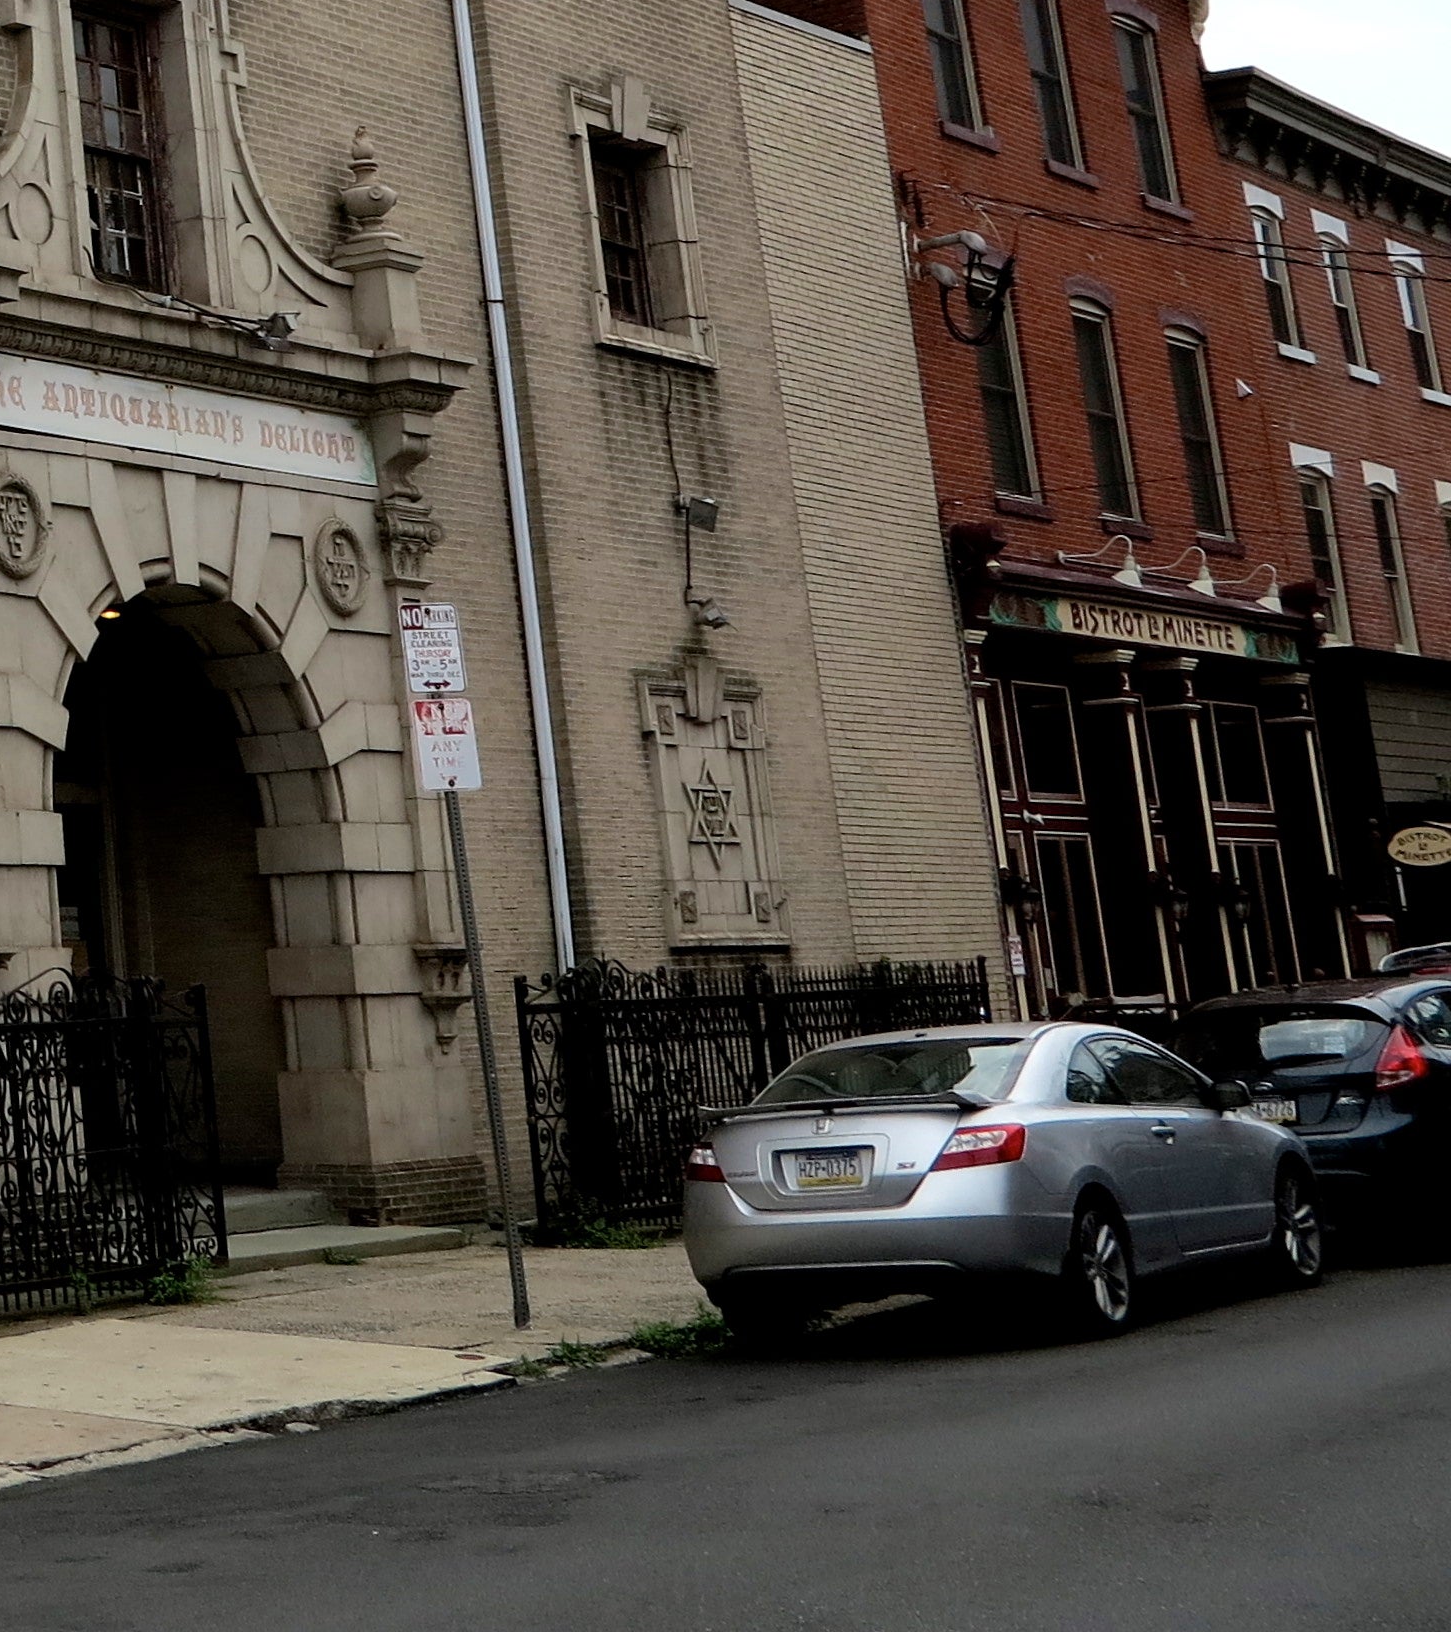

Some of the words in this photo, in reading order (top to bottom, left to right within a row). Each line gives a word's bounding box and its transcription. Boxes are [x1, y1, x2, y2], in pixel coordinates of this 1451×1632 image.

[42, 380, 244, 444] ANTIQUARIAN'S
[258, 419, 356, 464] DELIGHT
[402, 608, 422, 628] NO
[1070, 602, 1144, 638] BISTROT
[1163, 617, 1236, 649] MINETTE
[412, 631, 449, 640] STREET
[411, 639, 452, 648] CLEANING
[414, 649, 451, 659] THURSDAY
[431, 739, 462, 752] ANY
[433, 757, 466, 769] TIME
[1398, 832, 1448, 846] BISTROT
[799, 1156, 857, 1178] HZP-0375
